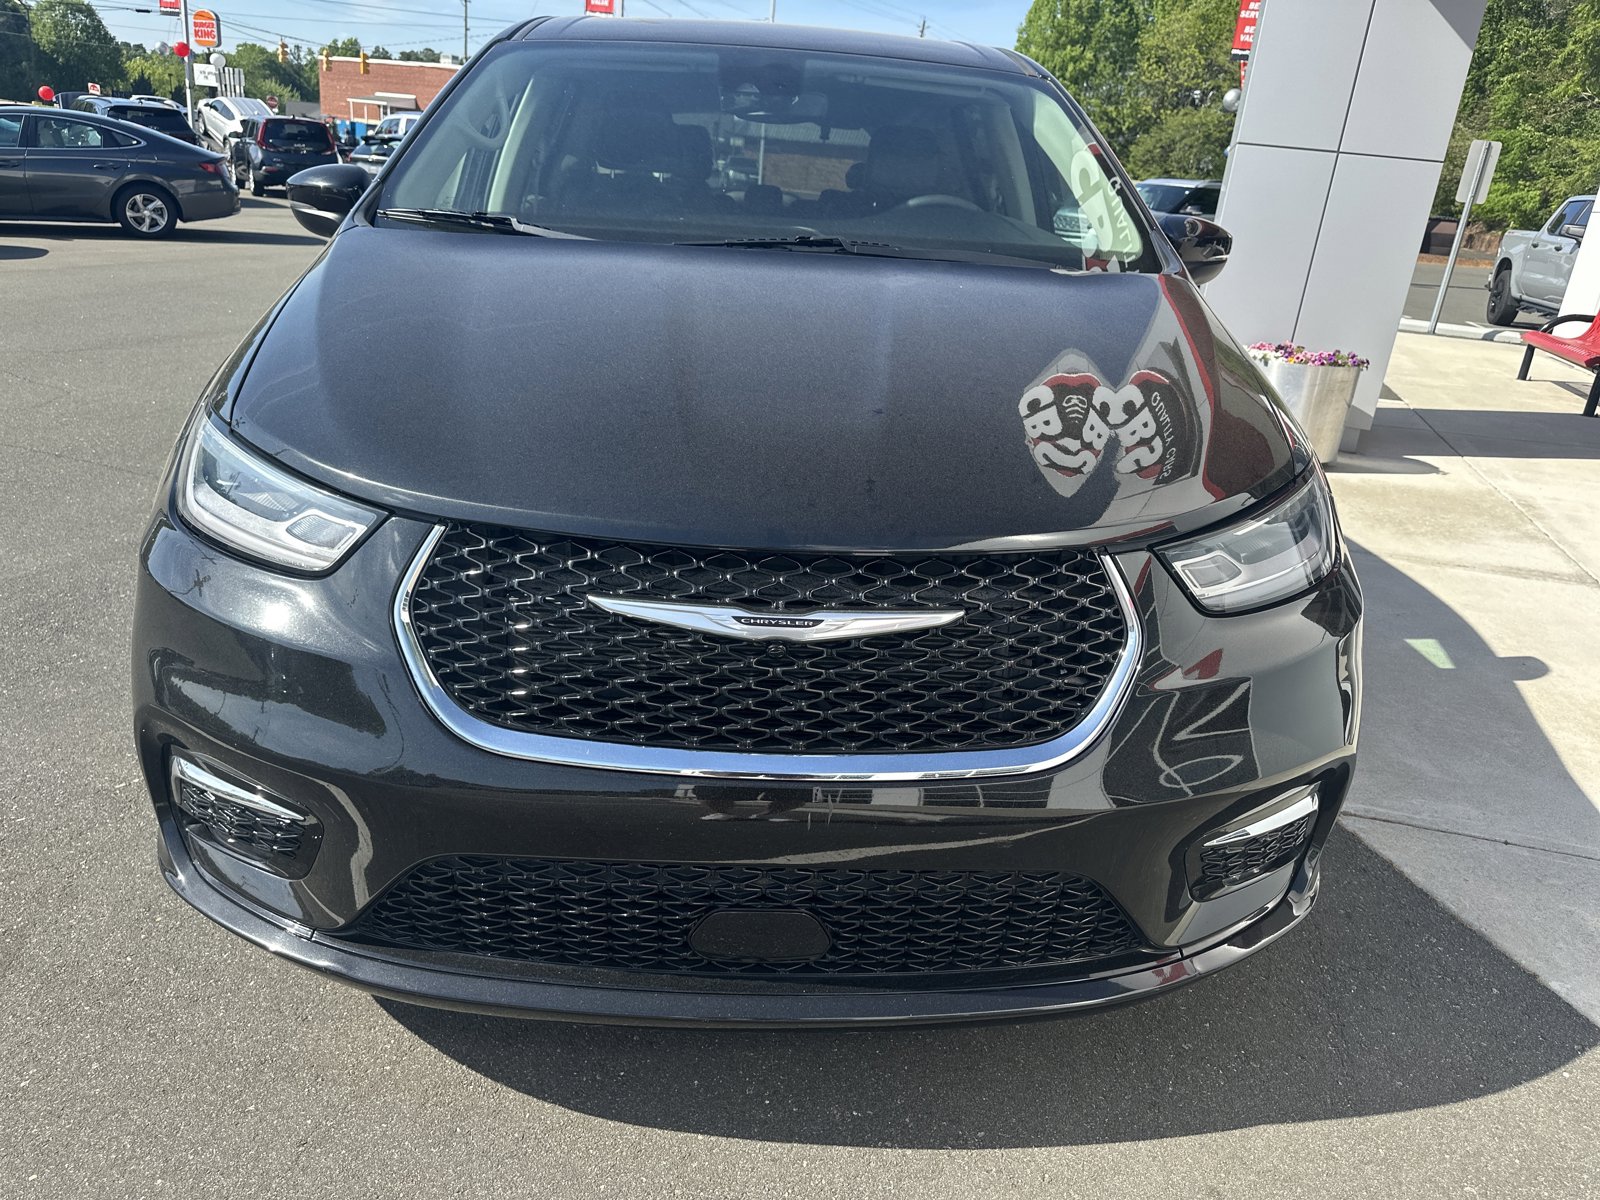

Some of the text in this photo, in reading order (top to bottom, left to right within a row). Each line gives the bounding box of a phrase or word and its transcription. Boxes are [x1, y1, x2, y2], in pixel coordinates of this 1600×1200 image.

[193, 21, 215, 29] BURGER
[194, 28, 217, 40] KING
[741, 618, 813, 626] CHRYSLER
